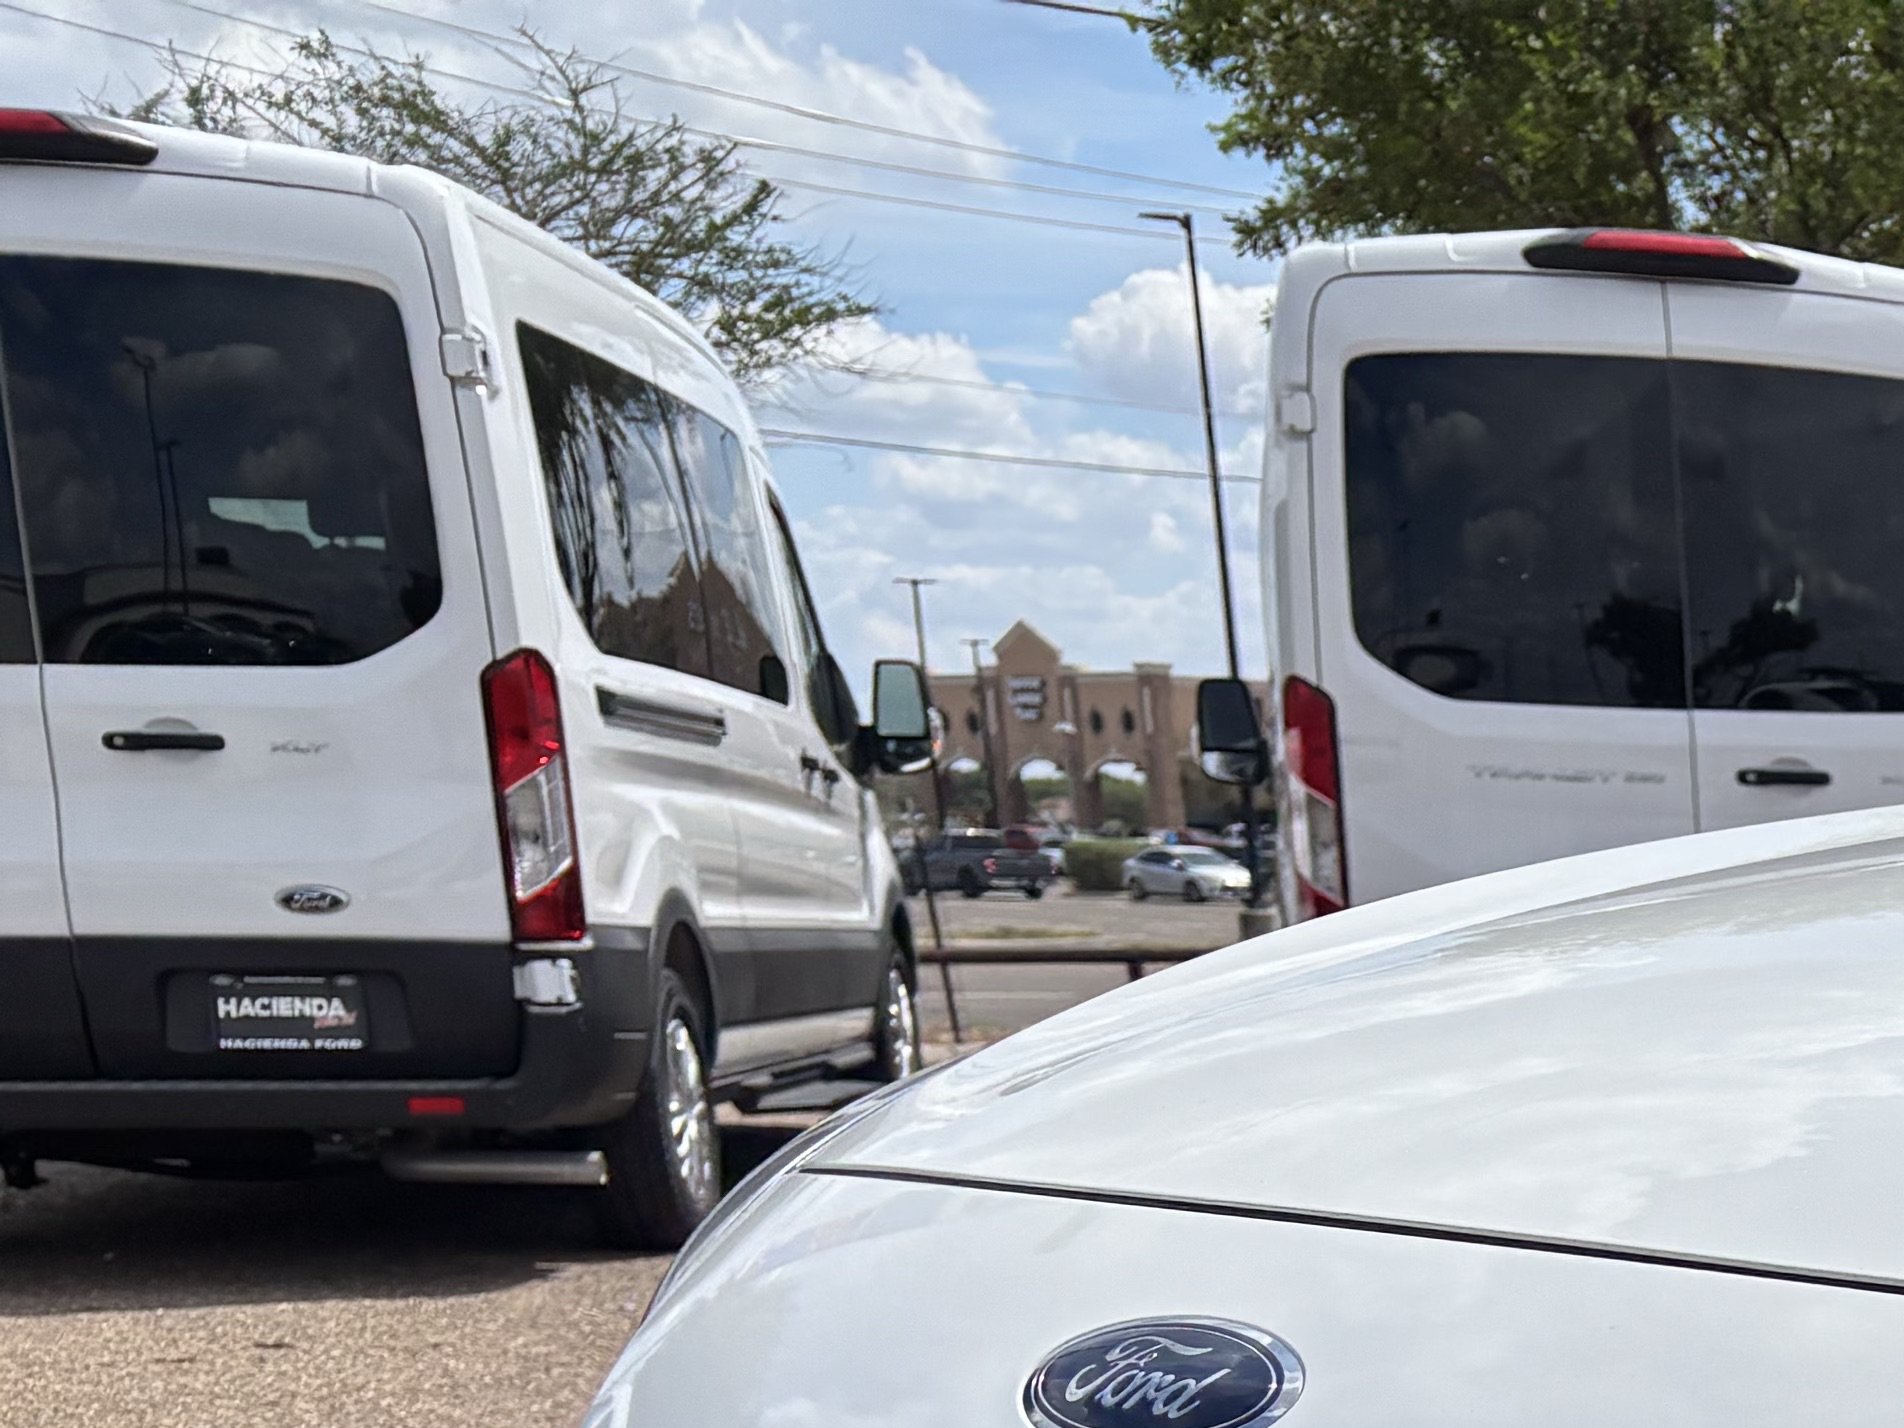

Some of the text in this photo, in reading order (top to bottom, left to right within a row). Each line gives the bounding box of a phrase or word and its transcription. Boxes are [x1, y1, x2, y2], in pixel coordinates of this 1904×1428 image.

[289, 890, 332, 910] Ford
[217, 996, 347, 1019] HACIENDA
[219, 1037, 311, 1051] HACIENDA
[1065, 1334, 1231, 1420] Ford
